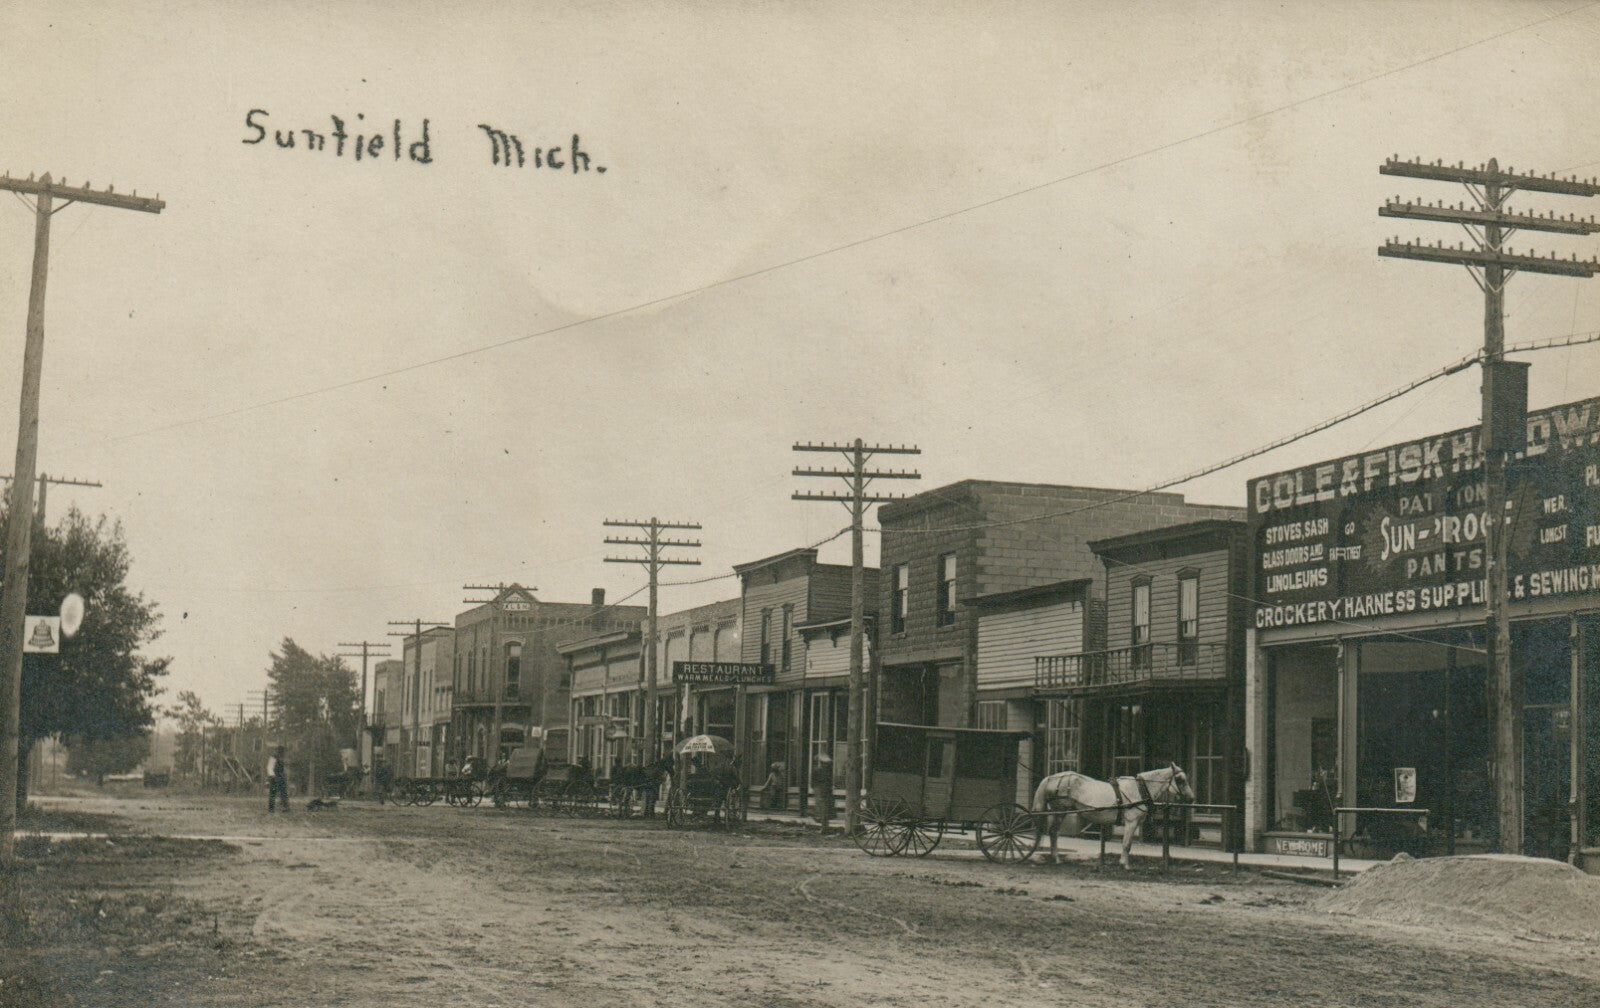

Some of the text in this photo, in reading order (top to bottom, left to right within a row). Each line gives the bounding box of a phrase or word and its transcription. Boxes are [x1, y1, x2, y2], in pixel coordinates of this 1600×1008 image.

[1255, 463, 1335, 514] COLE
[1340, 459, 1358, 498] &
[1363, 438, 1444, 491] FISK
[1305, 517, 1330, 538] SASH
[1344, 521, 1356, 536] GO
[1262, 549, 1284, 570] GLASS
[1285, 545, 1309, 566] DOORS
[1266, 567, 1328, 594] LINOLEUMS
[1345, 590, 1416, 618] HARNESS
[1514, 575, 1525, 599] &
[1530, 565, 1589, 596] SEWING
[677, 673, 701, 681] WARM
[702, 674, 729, 682] MEALS
[684, 663, 764, 675] RESTAURANT
